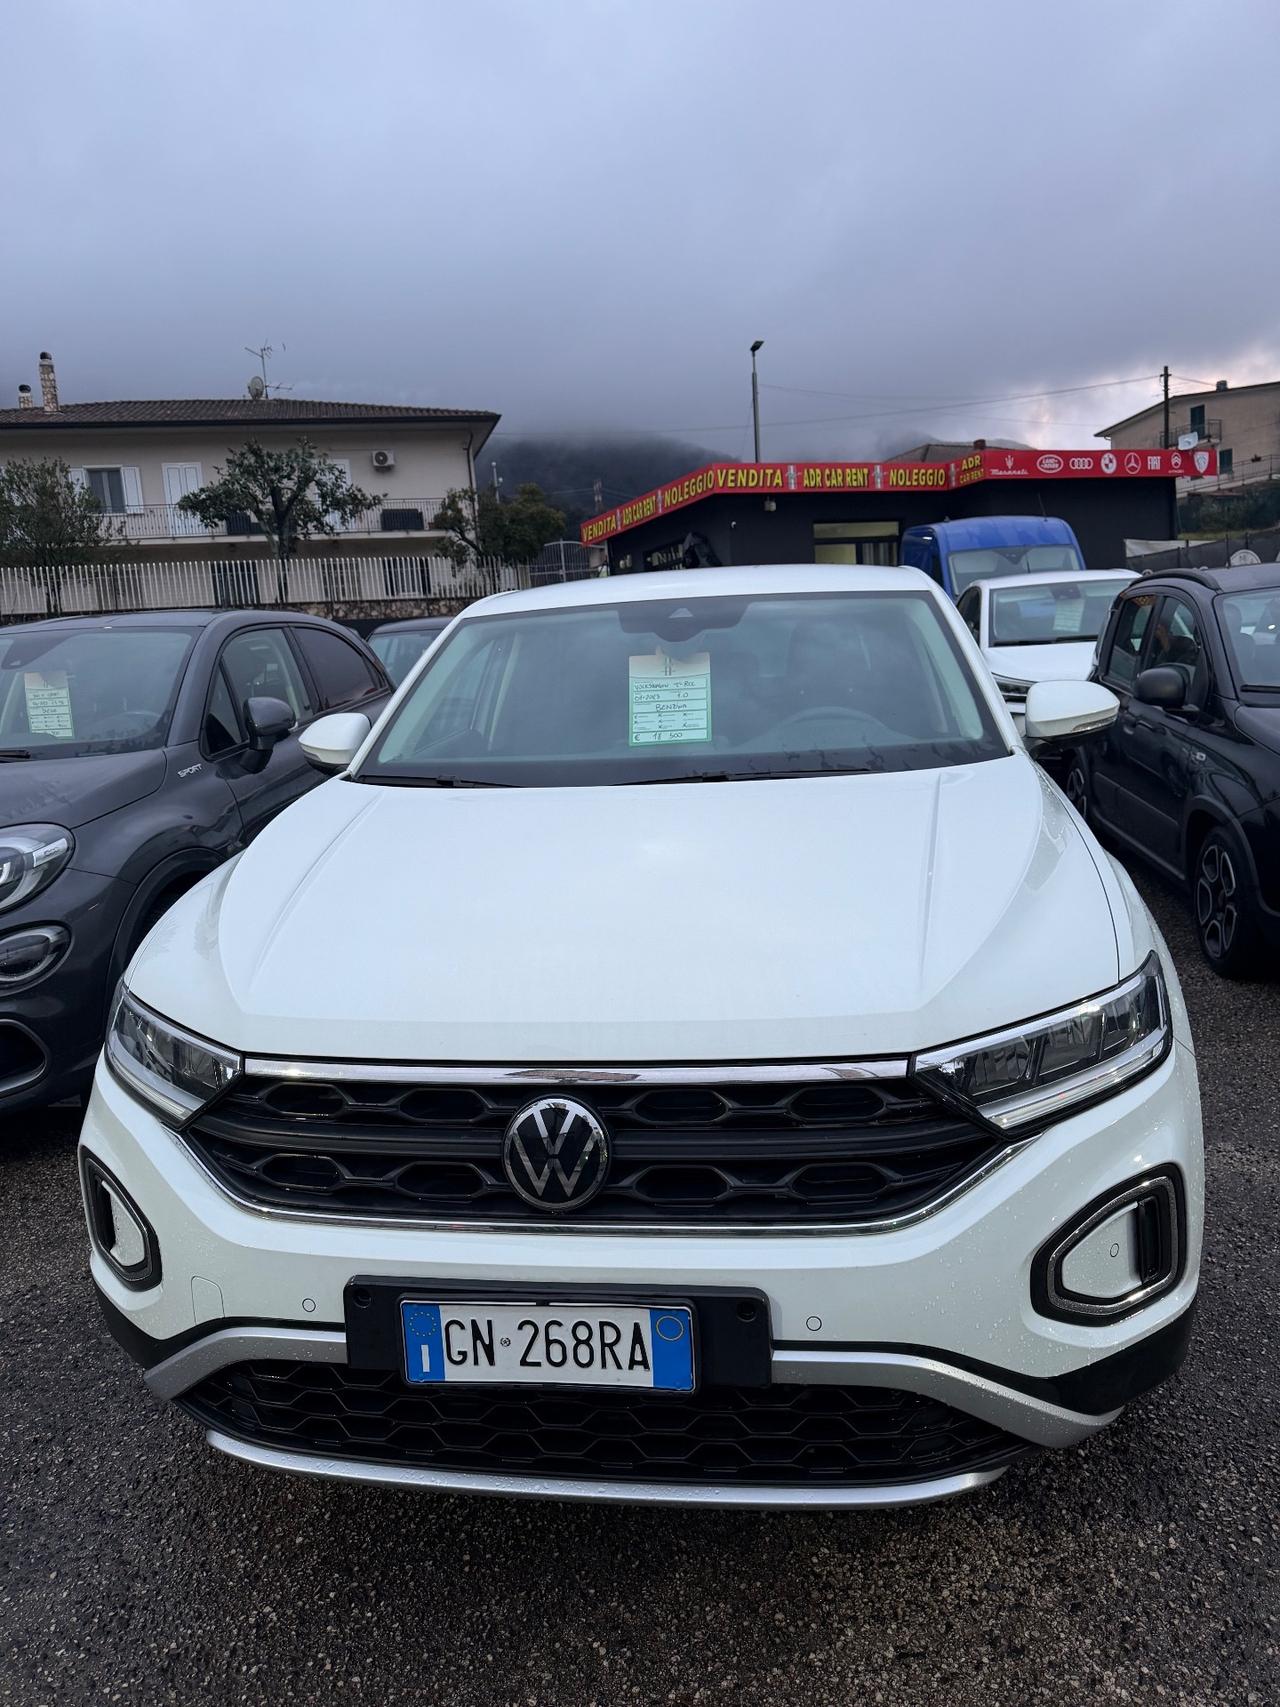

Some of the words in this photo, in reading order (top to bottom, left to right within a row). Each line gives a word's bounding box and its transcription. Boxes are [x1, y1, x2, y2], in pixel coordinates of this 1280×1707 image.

[961, 455, 981, 470] ADR
[1147, 456, 1161, 471] FIAT
[717, 468, 783, 488] VENDITA
[803, 468, 822, 487] ADR
[824, 468, 844, 487] CAR
[846, 468, 869, 487] RENT
[889, 468, 946, 486] NOLEGGIO
[664, 470, 714, 508] NOLEGGIO
[623, 506, 633, 525] ADR
[633, 501, 643, 521] CAR
[643, 495, 656, 517] RENT
[582, 514, 617, 542] VENDITA
[177, 763, 201, 778] SPORT
[444, 1318, 496, 1366] GN
[517, 1319, 651, 1371] 268RA
